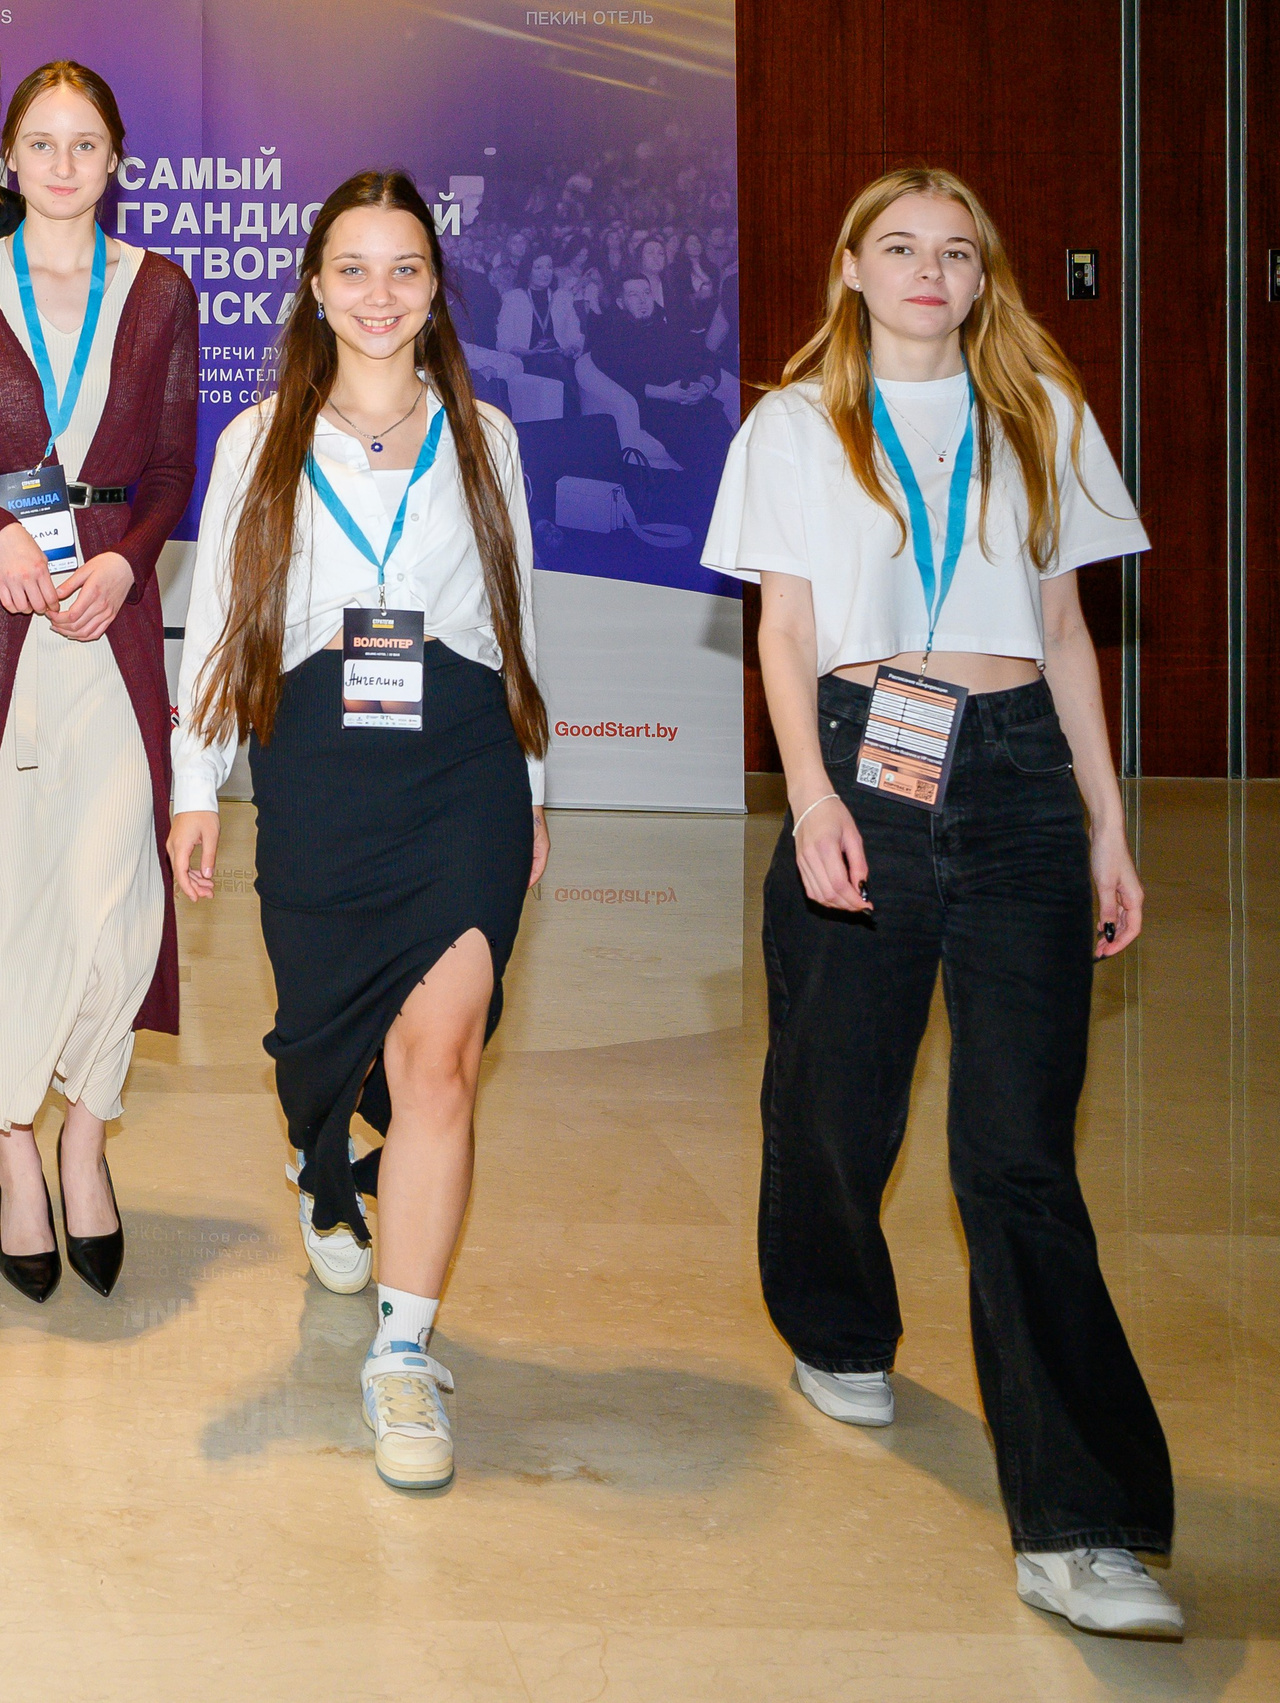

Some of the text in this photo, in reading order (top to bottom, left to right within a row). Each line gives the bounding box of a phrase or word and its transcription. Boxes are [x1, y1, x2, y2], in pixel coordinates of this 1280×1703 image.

[526, 10, 654, 25] ПЕКИН ОТЕЛЬ
[117, 146, 282, 191] САМЫЙ
[117, 192, 461, 243] ГРАНДИОЙ
[8, 493, 60, 510] КОМАНДА
[353, 637, 414, 649] ВОЛОНТЕР
[345, 663, 404, 687] Ангелина
[554, 721, 678, 741] GoodStart.by
